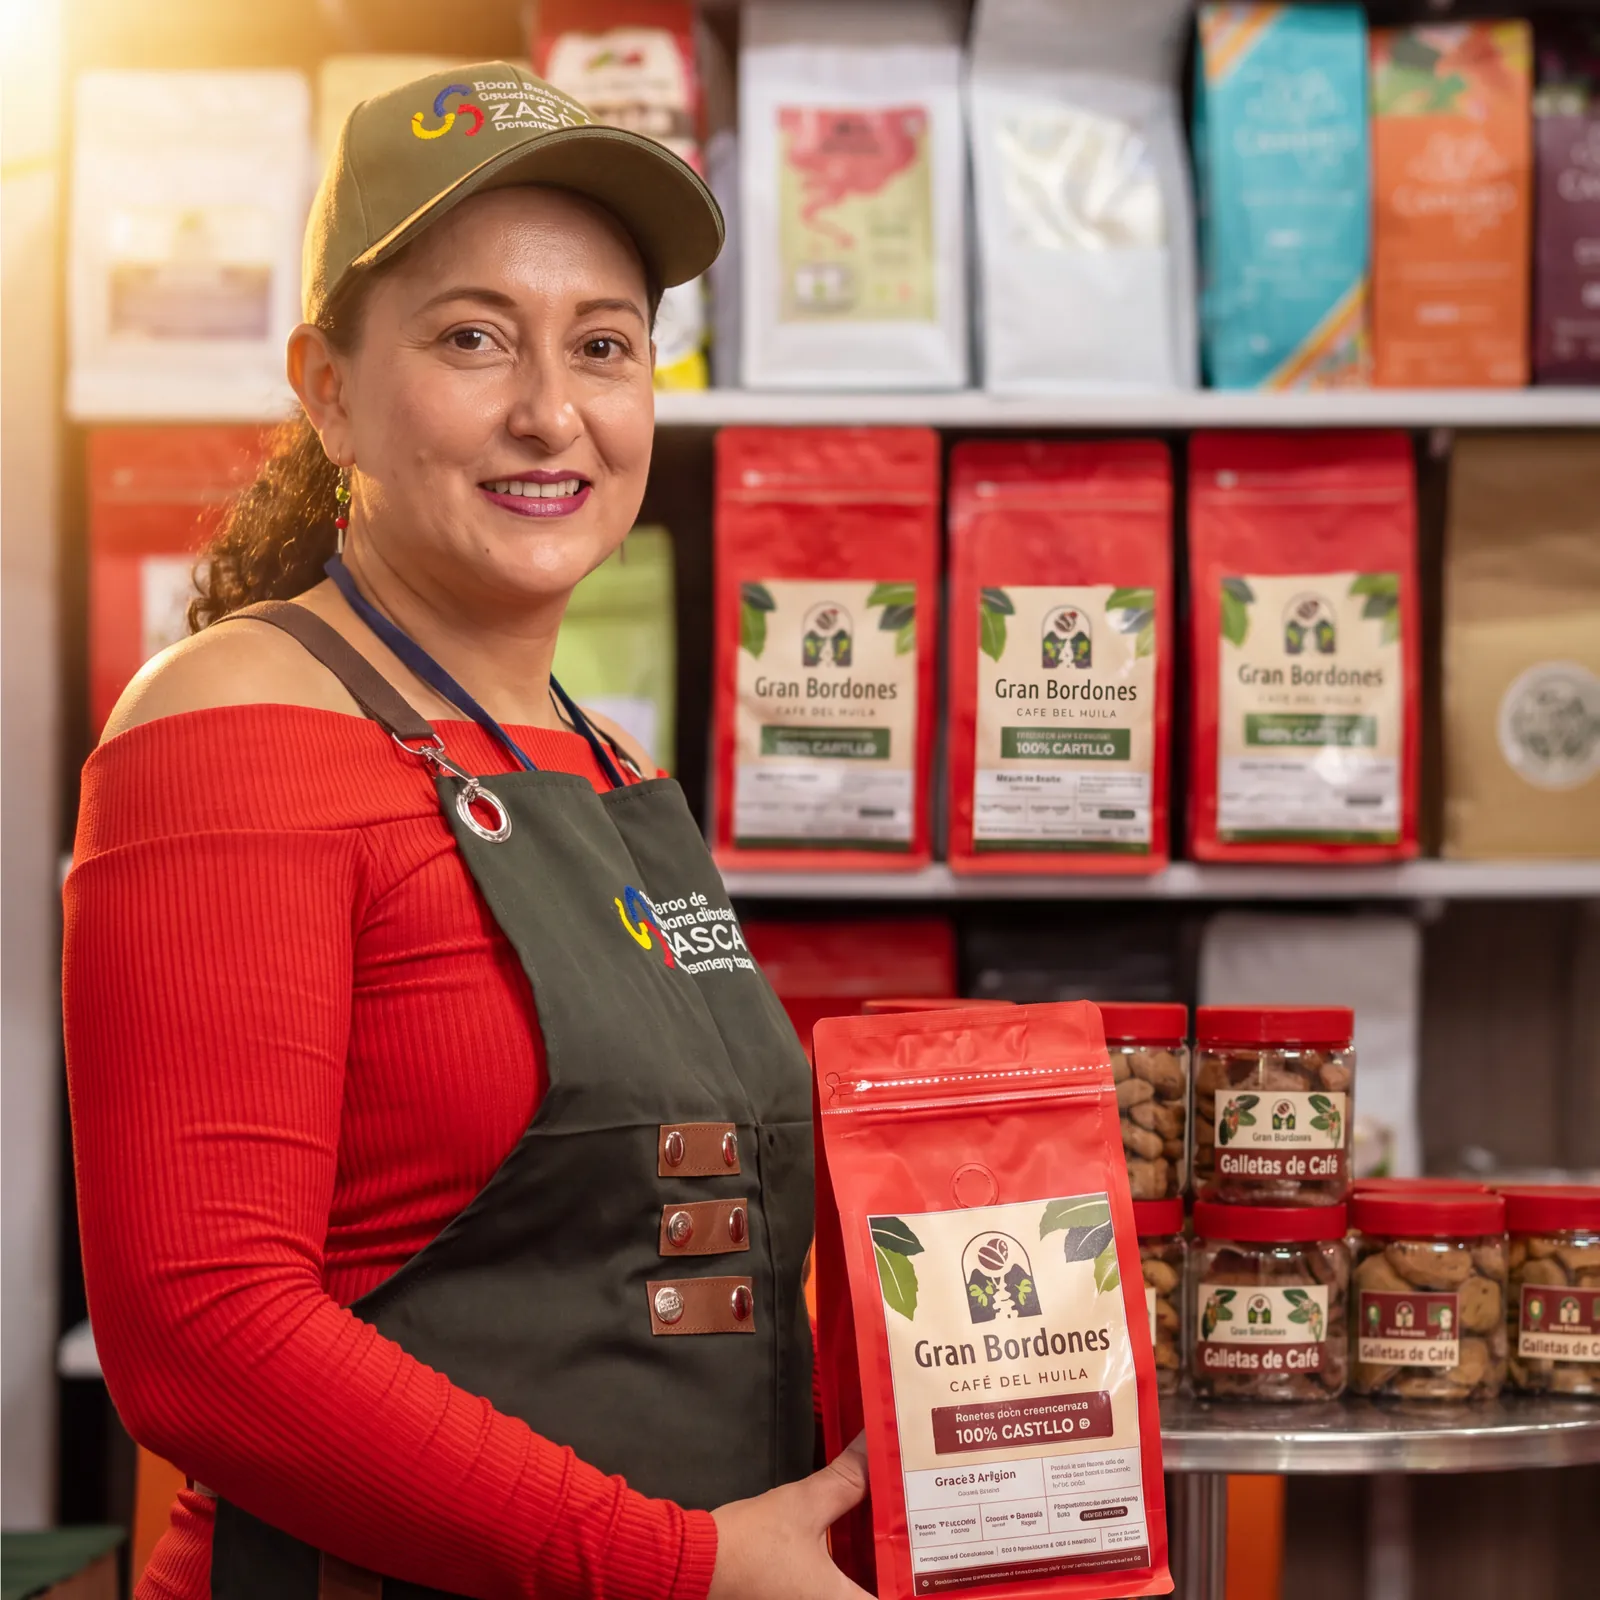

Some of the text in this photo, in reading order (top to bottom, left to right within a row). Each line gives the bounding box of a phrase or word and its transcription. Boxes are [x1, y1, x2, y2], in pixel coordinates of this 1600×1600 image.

[1238, 664, 1384, 687] Gran Bordones
[754, 676, 898, 699] Gran Bordones
[995, 678, 1138, 701] Gran Bordones
[1015, 741, 1050, 755] 100%
[689, 891, 709, 907] de
[1252, 1132, 1272, 1142] Gran
[1220, 1154, 1338, 1175] Galletas de Café
[914, 1327, 1111, 1368] Gran Bordones
[1362, 1344, 1456, 1361] Galletas de Café
[1523, 1338, 1569, 1355] Galletas
[1572, 1340, 1588, 1356] de
[1204, 1347, 1319, 1369] Galletas de Café
[949, 1367, 1089, 1393] CAFÉ DEL HUILA
[956, 1426, 998, 1445] 100%
